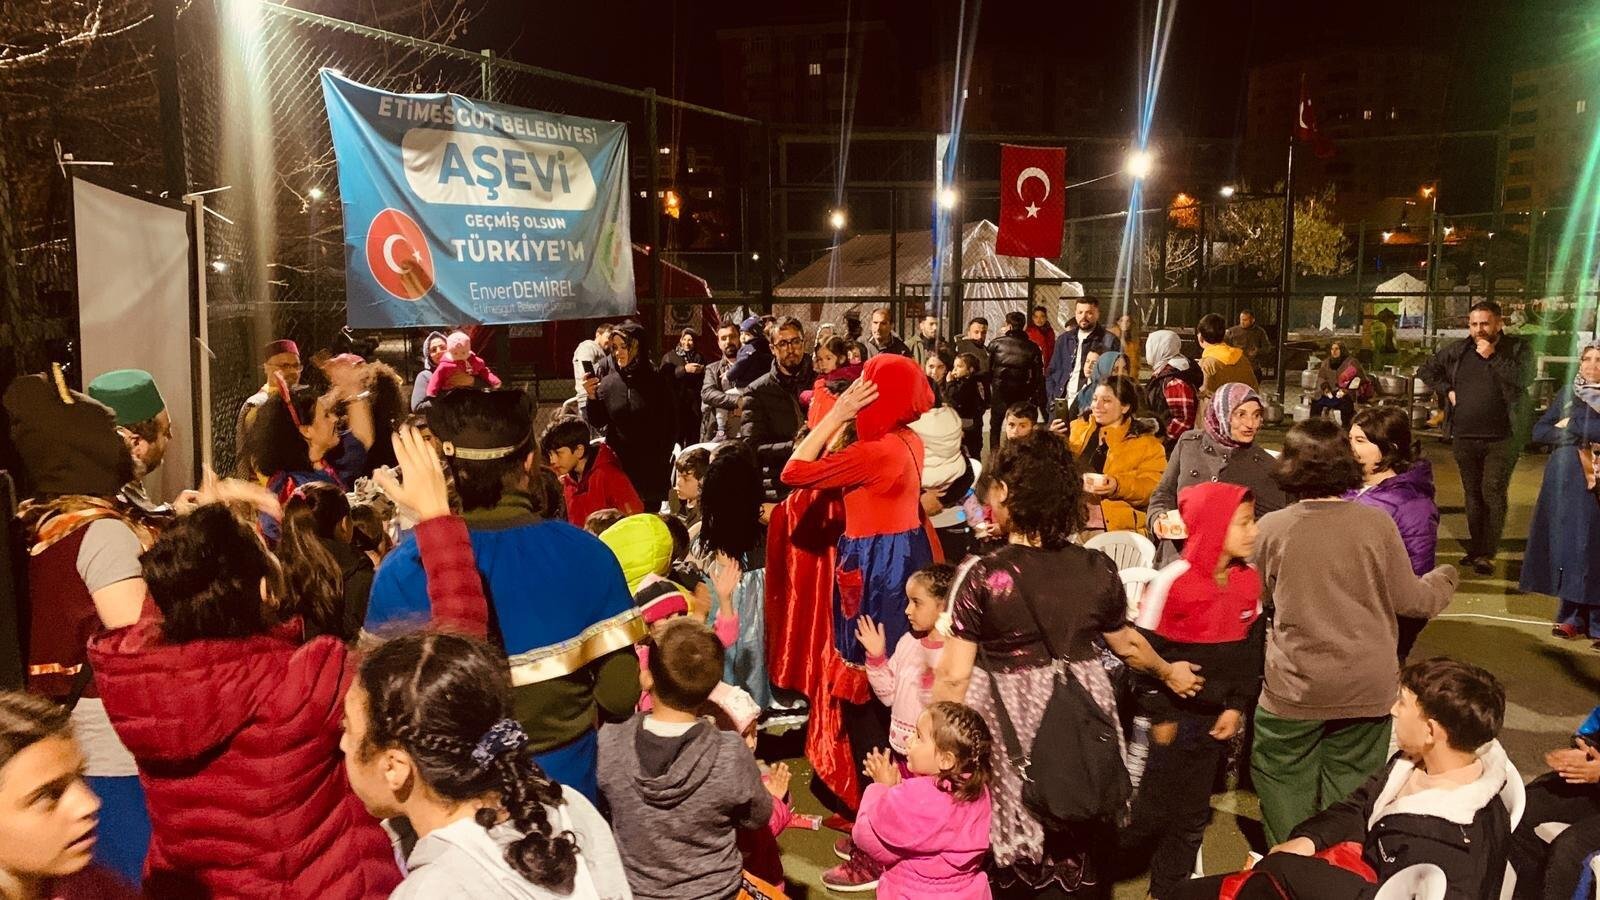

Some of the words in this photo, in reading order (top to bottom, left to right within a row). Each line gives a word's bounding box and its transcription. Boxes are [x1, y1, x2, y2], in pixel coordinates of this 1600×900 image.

[465, 211, 520, 231] GEÇMİŞ
[523, 217, 566, 229] OLSUN
[451, 233, 585, 262] TÜRKİYE'M
